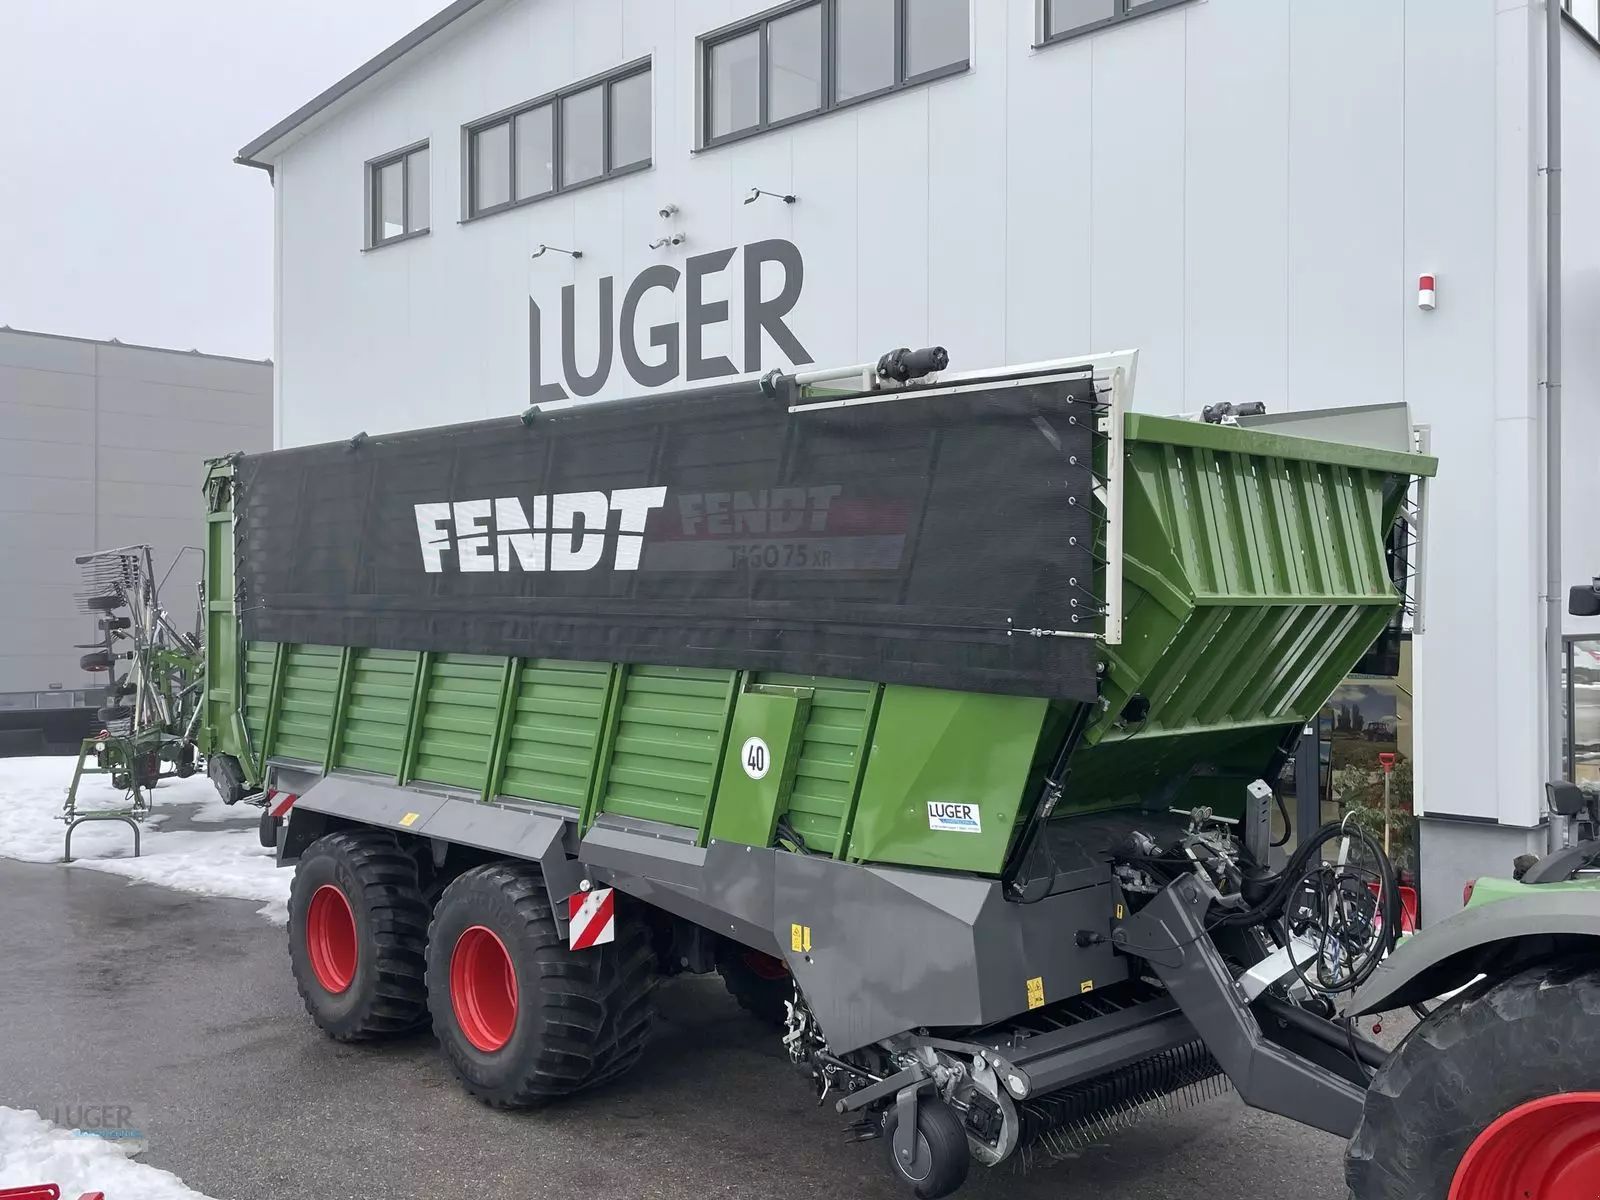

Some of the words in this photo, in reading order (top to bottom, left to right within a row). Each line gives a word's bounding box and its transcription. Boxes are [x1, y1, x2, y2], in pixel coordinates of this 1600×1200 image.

[529, 239, 815, 404] LUGER
[677, 485, 842, 535] FENDT
[414, 486, 668, 573] FENDT
[784, 544, 808, 568] 75
[748, 745, 764, 772] 40
[929, 804, 973, 820] LUGER
